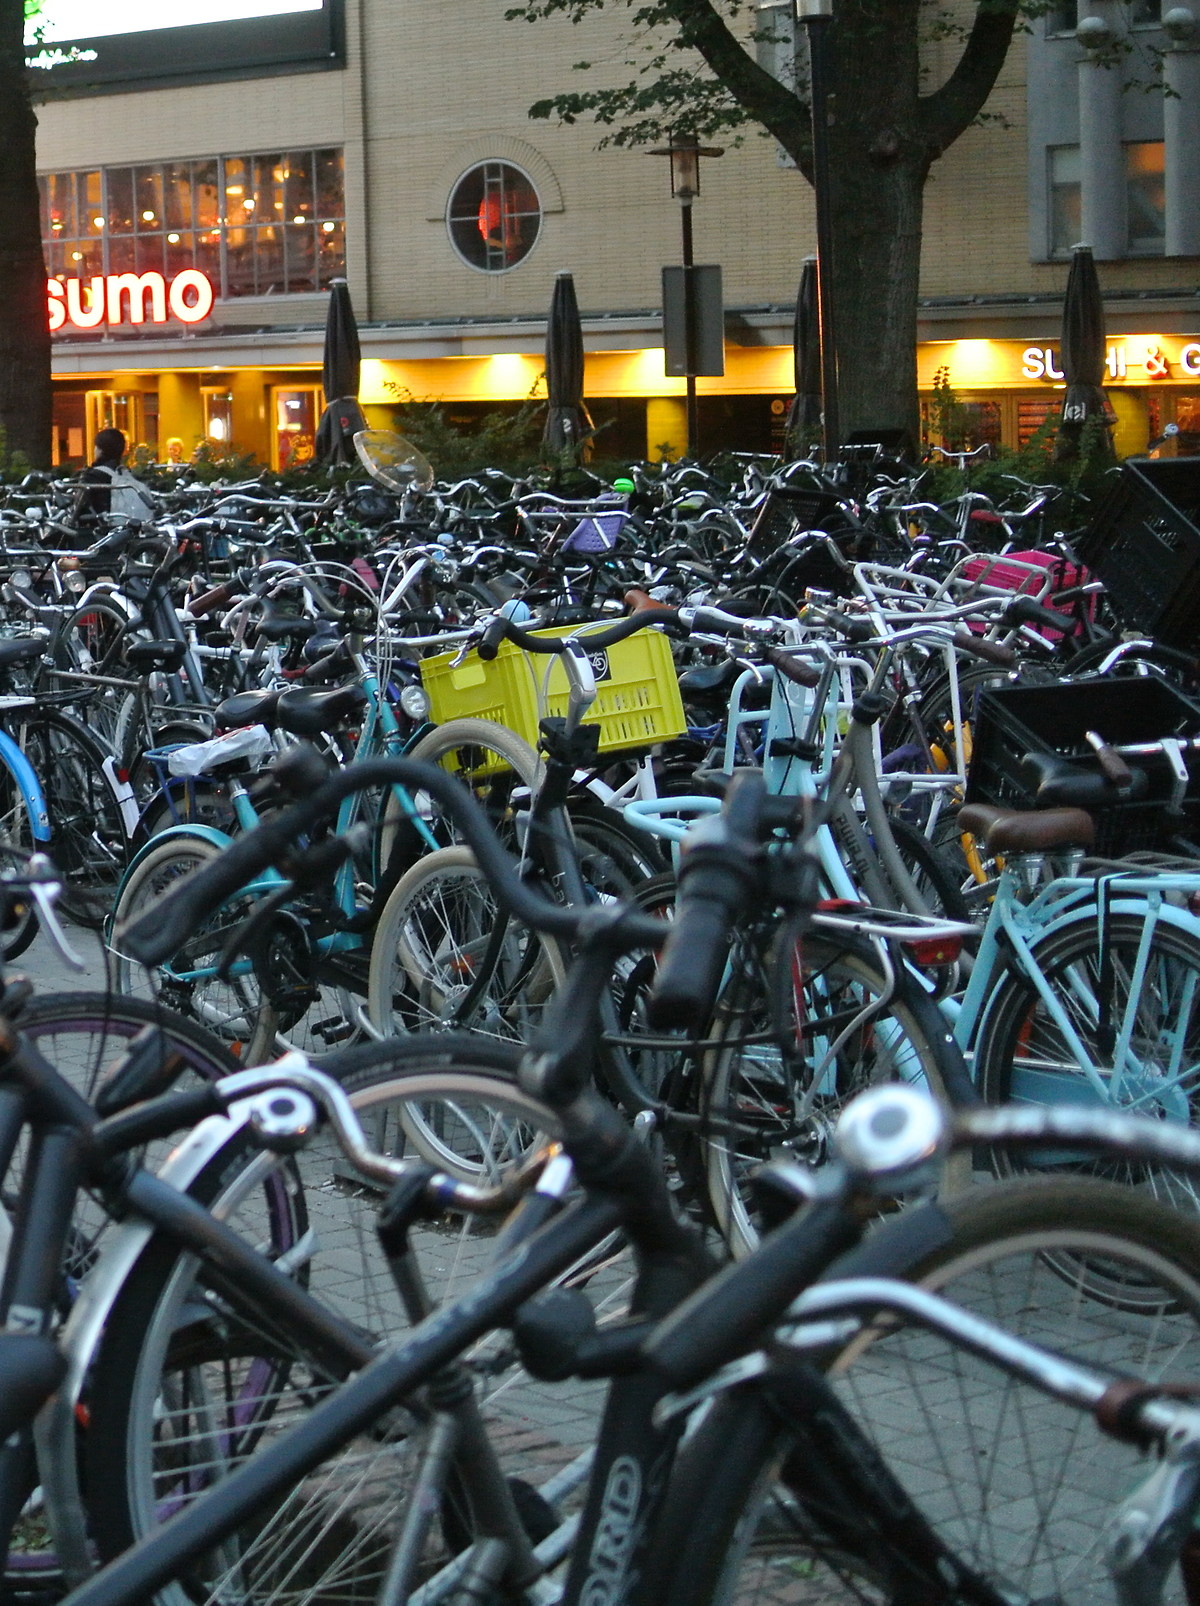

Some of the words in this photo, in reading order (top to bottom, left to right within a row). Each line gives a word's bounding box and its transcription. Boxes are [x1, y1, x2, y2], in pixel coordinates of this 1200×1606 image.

[46, 268, 215, 332] sumo
[1021, 346, 1127, 379] SUHI
[1144, 346, 1168, 376] &
